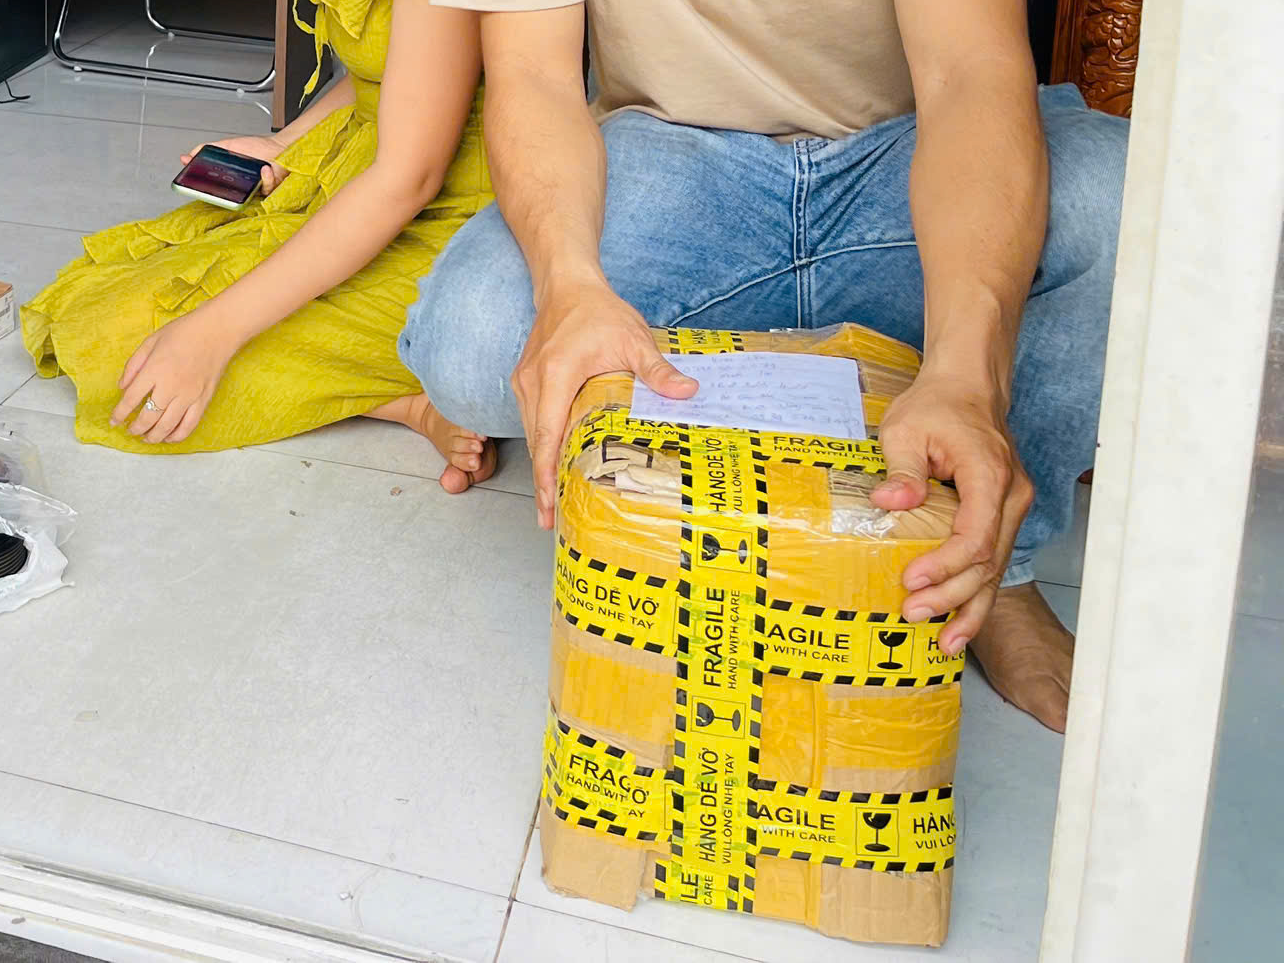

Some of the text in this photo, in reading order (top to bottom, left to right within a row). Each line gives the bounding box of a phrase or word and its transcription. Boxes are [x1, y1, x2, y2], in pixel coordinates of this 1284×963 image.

[625, 426, 661, 434] HAND
[773, 436, 883, 455] FRAGILE
[773, 445, 810, 454] HAND
[815, 449, 852, 458] WITH
[556, 556, 660, 617] HÀNG DỄ VỠ
[597, 606, 626, 623] NHẸ
[630, 616, 655, 630] TAY
[703, 587, 725, 687] FRAGILE
[728, 589, 741, 690] HAND WITH CARE
[767, 623, 851, 650] AGILE
[774, 645, 808, 658] WITH
[811, 650, 850, 663] CARE
[698, 747, 719, 781] VỠ
[724, 753, 735, 775] TAY
[567, 773, 601, 793] HAND
[757, 805, 836, 831] AGILE
[696, 814, 717, 864] HÀNG
[762, 825, 836, 844] WITH CARE
[915, 838, 938, 850] VUI
[722, 847, 732, 865] VUI
[703, 874, 714, 905] CARE
